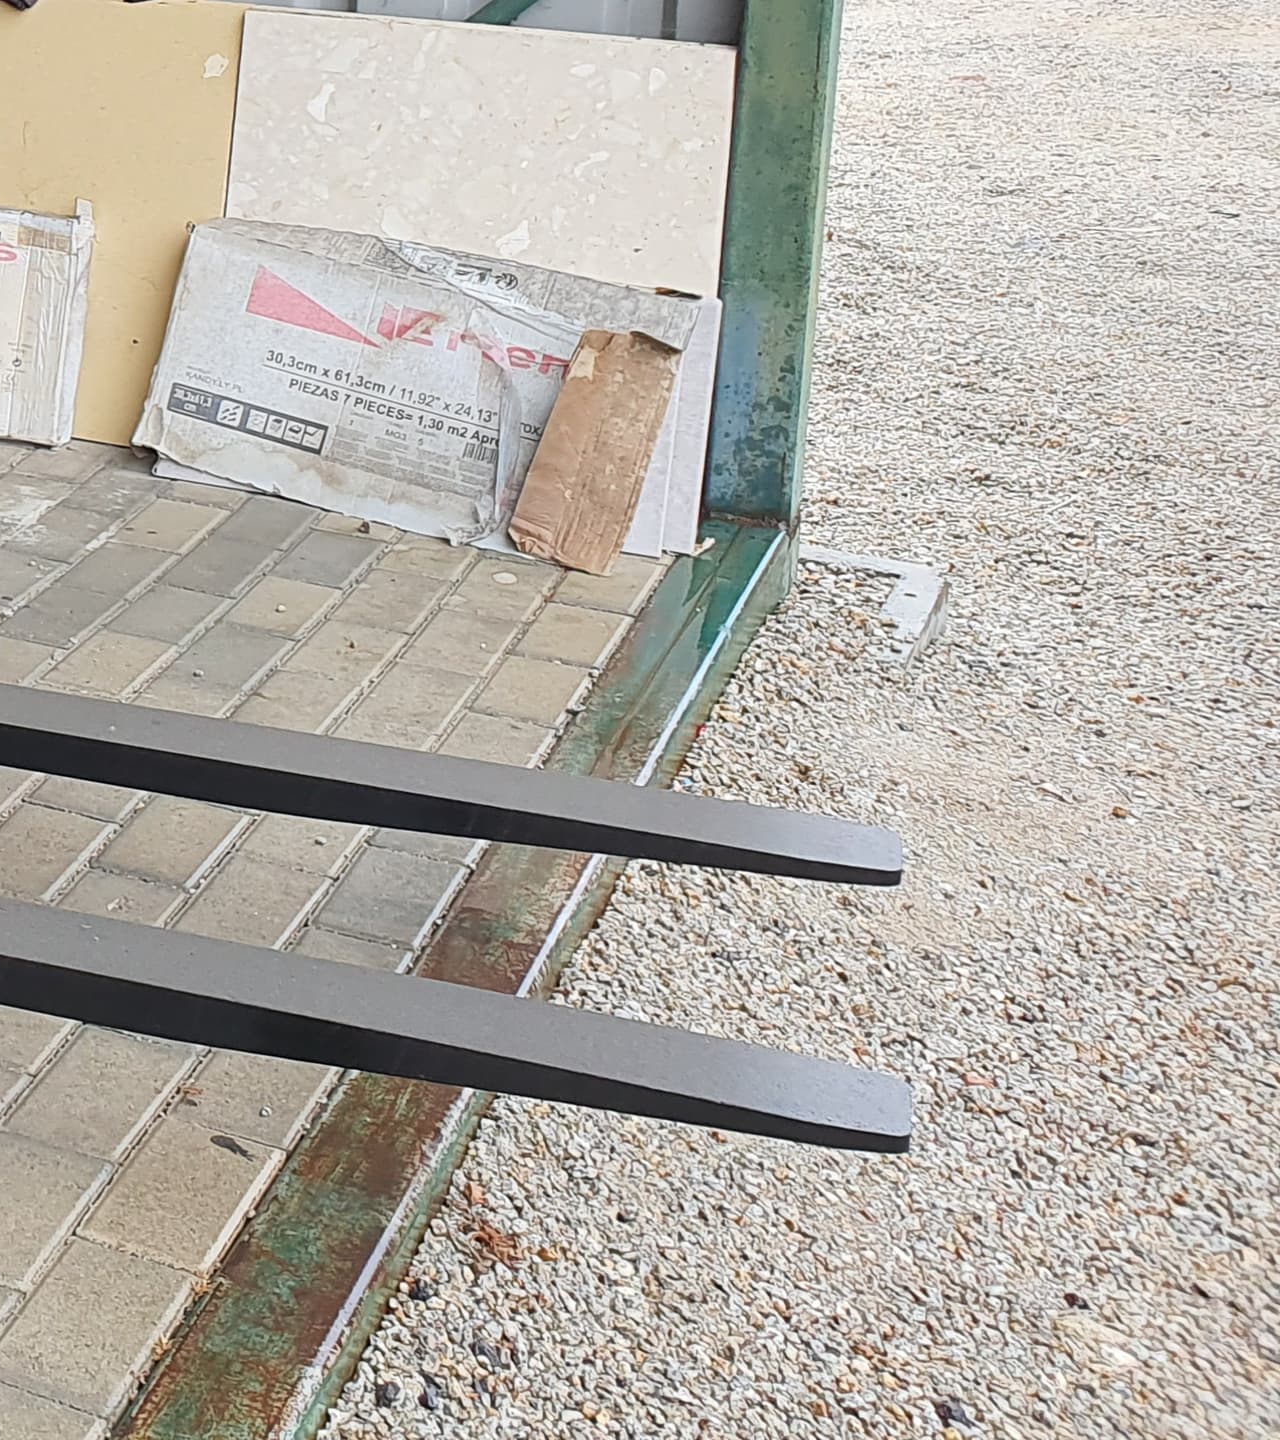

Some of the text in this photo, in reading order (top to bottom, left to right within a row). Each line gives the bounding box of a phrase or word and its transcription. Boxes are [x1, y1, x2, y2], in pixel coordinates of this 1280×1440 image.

[265, 350, 317, 374] 30,3cm
[321, 367, 330, 378] x
[334, 369, 386, 394] 61,3cm
[443, 402, 452, 412] x
[289, 378, 339, 401] PIEZAS
[344, 393, 352, 405] 7
[417, 414, 444, 431] 1,30
[447, 425, 467, 439] m2
